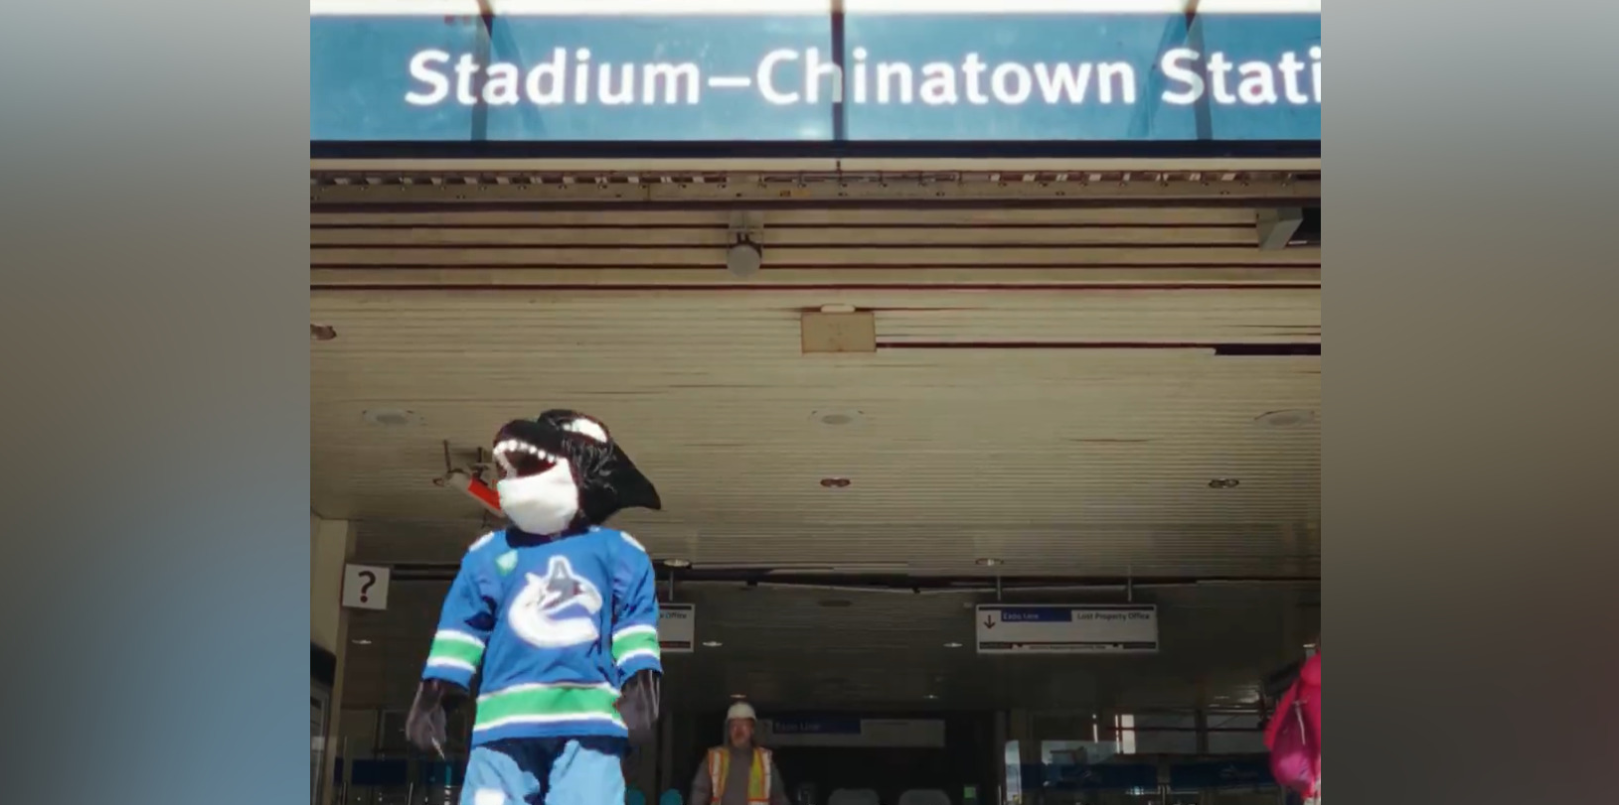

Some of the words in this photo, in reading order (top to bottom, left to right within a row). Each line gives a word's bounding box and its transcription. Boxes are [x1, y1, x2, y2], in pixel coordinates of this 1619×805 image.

[358, 570, 376, 603] ?
[1077, 612, 1093, 620] Lost
[1095, 612, 1127, 622] Property
[1128, 612, 1150, 620] Office
